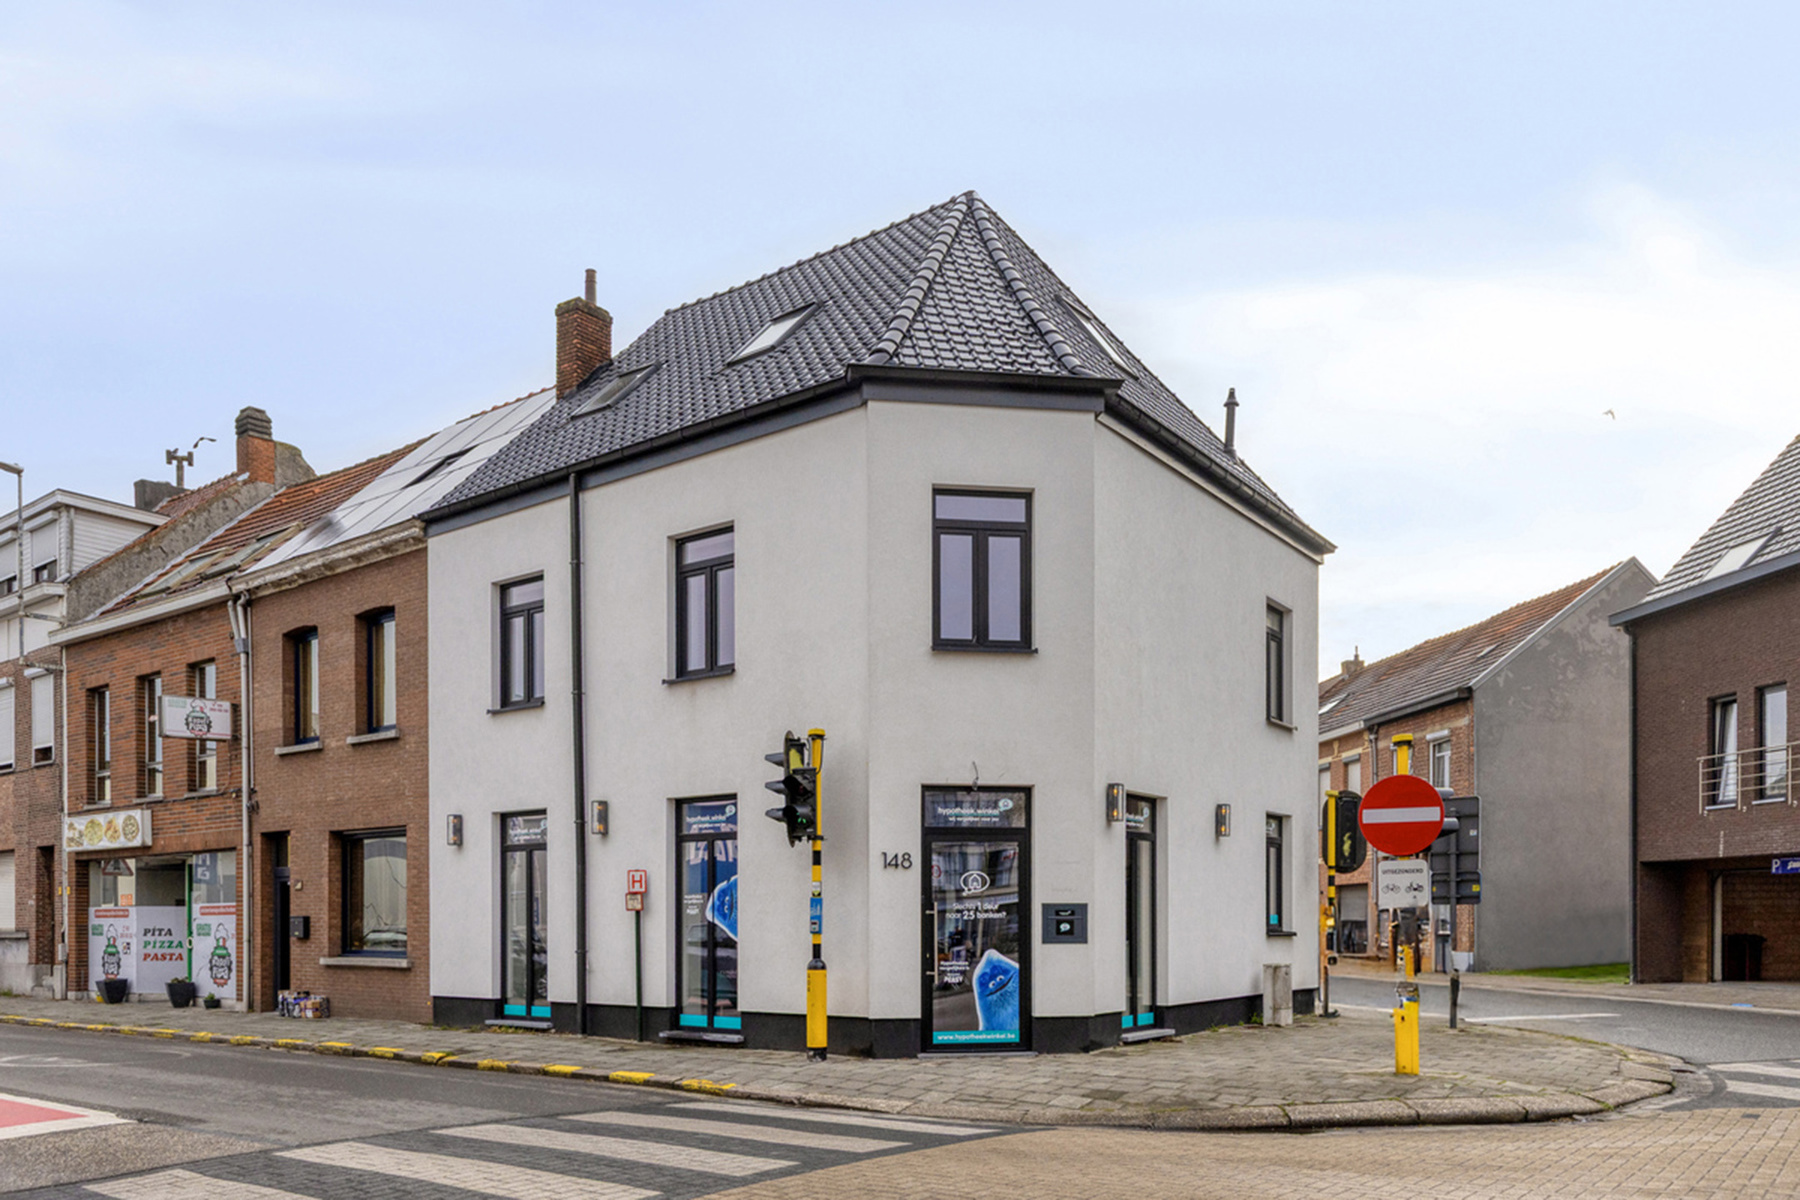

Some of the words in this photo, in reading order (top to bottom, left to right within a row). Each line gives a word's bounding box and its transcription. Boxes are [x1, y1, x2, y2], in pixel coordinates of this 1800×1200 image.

[881, 851, 913, 870] 148
[1772, 858, 1781, 873] P
[631, 873, 643, 889] H
[983, 901, 998, 910] deur
[963, 910, 975, 920] 25
[977, 911, 1007, 919] banken?
[143, 952, 184, 961] PASTA
